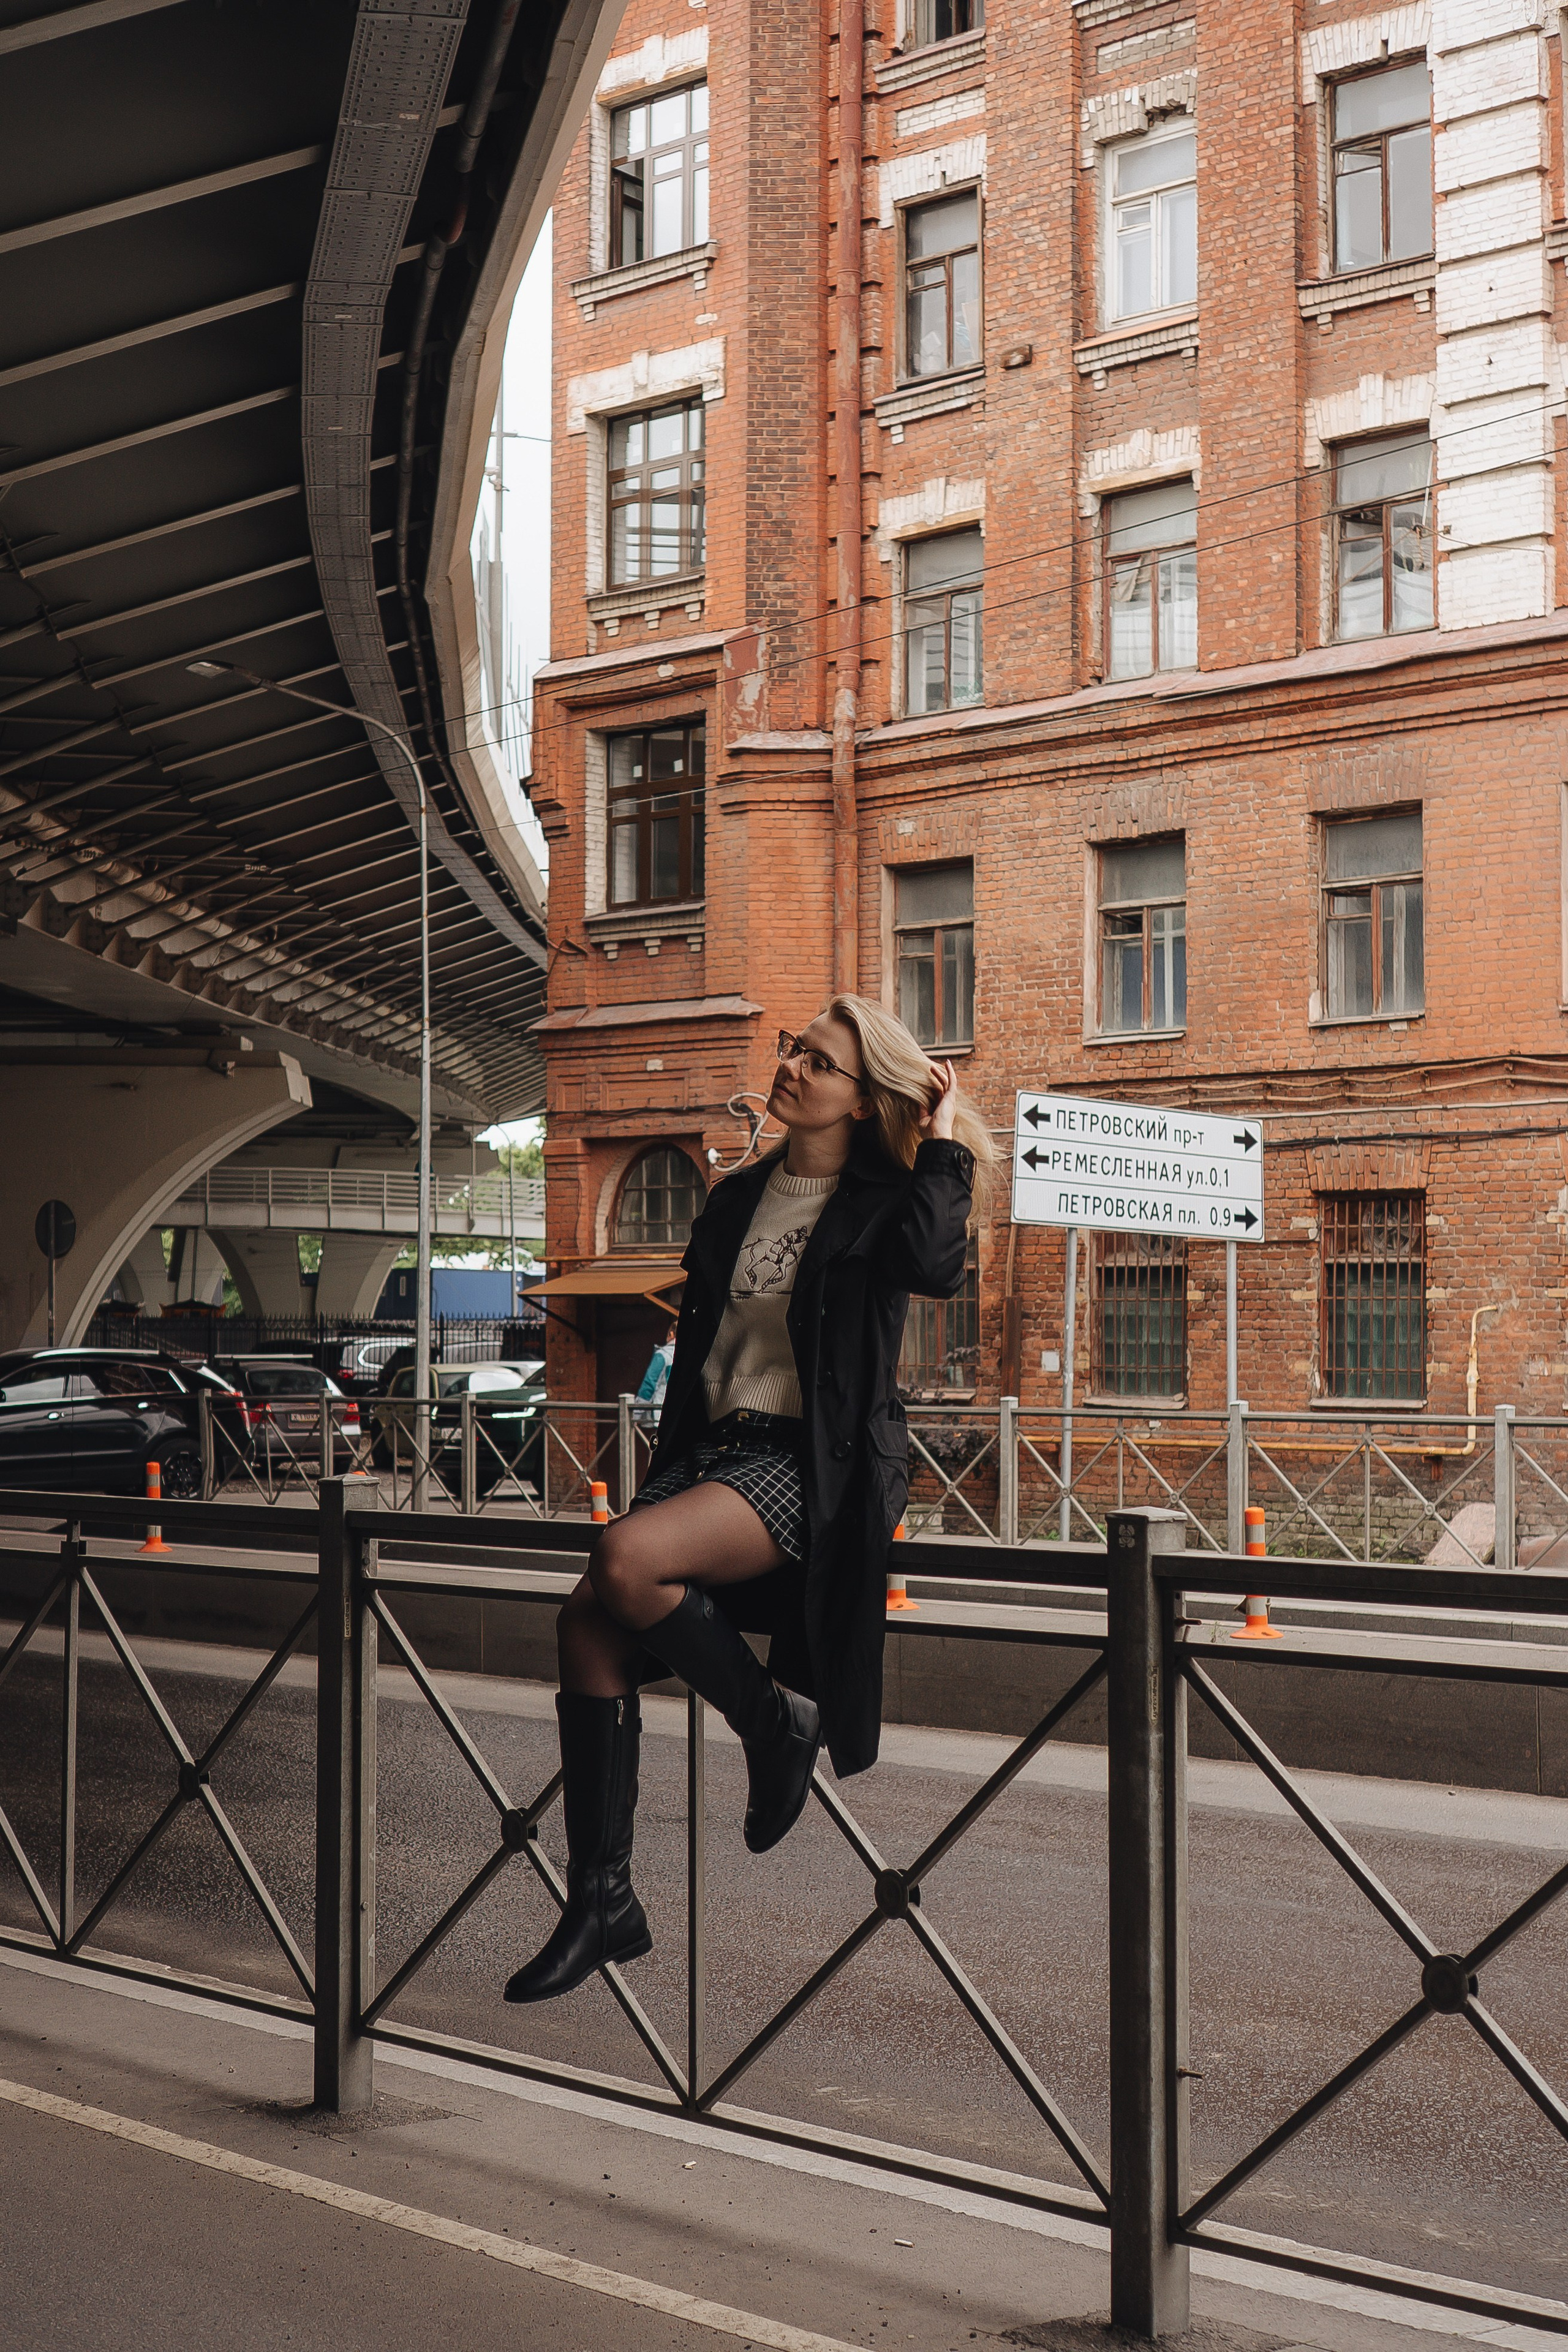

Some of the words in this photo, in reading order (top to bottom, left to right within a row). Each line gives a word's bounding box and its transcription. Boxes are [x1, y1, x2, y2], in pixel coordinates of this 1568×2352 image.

[1057, 1109, 1167, 1141] ПЕТРОВСКИЙ
[1174, 1129, 1204, 1148] пр-т
[1052, 1150, 1181, 1183] РЕМЕСЛЕННАЯ
[1058, 1193, 1172, 1222] ПЕТРОВСКАЯ
[1178, 1210, 1200, 1224] пл.
[1210, 1207, 1231, 1227] 0,9
